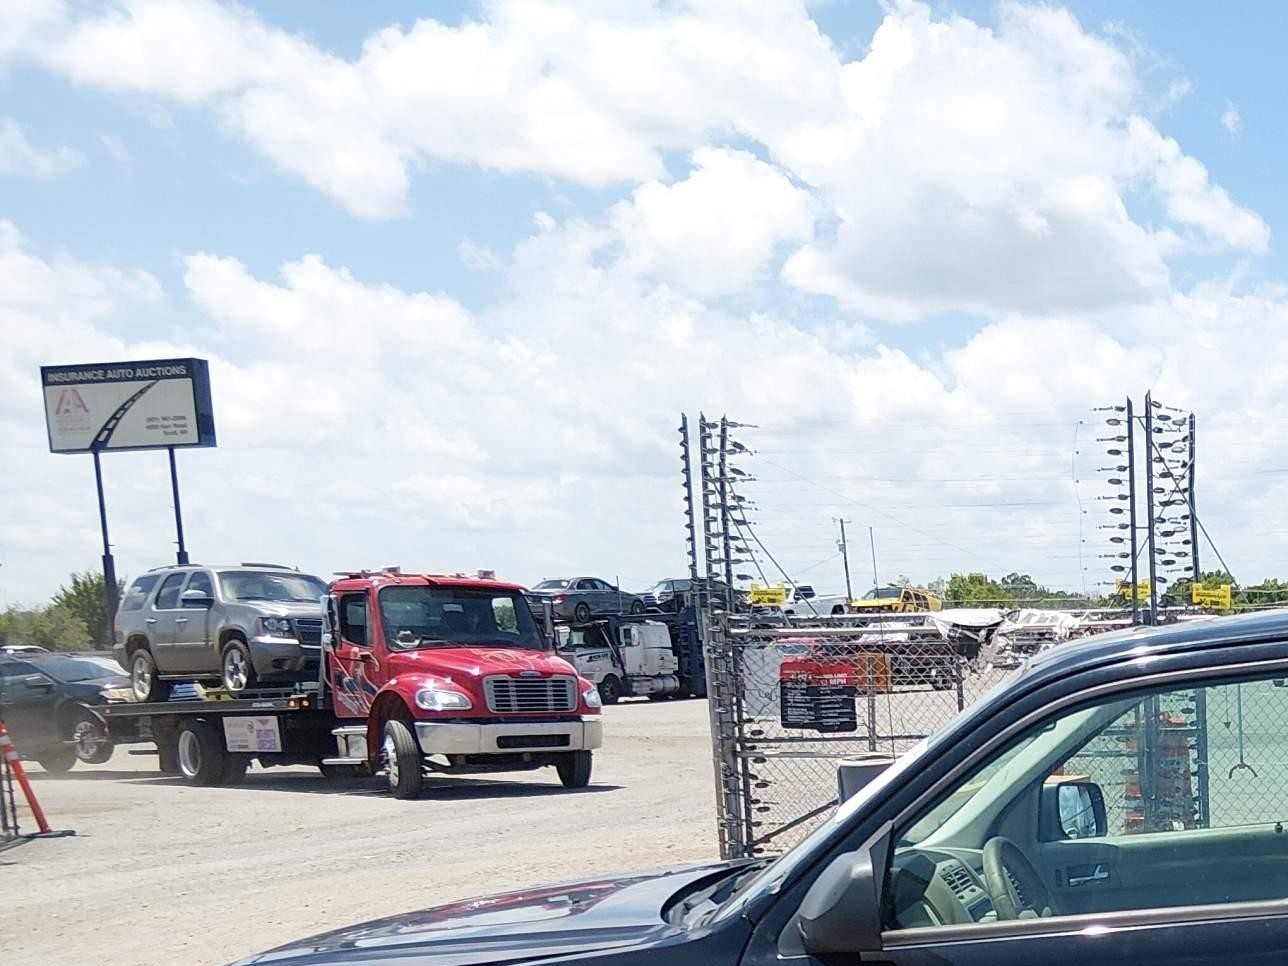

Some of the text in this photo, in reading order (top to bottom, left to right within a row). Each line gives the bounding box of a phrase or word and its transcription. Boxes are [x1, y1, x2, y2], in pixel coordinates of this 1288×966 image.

[48, 365, 187, 382] INSURANCE AUTO AUCTIONS
